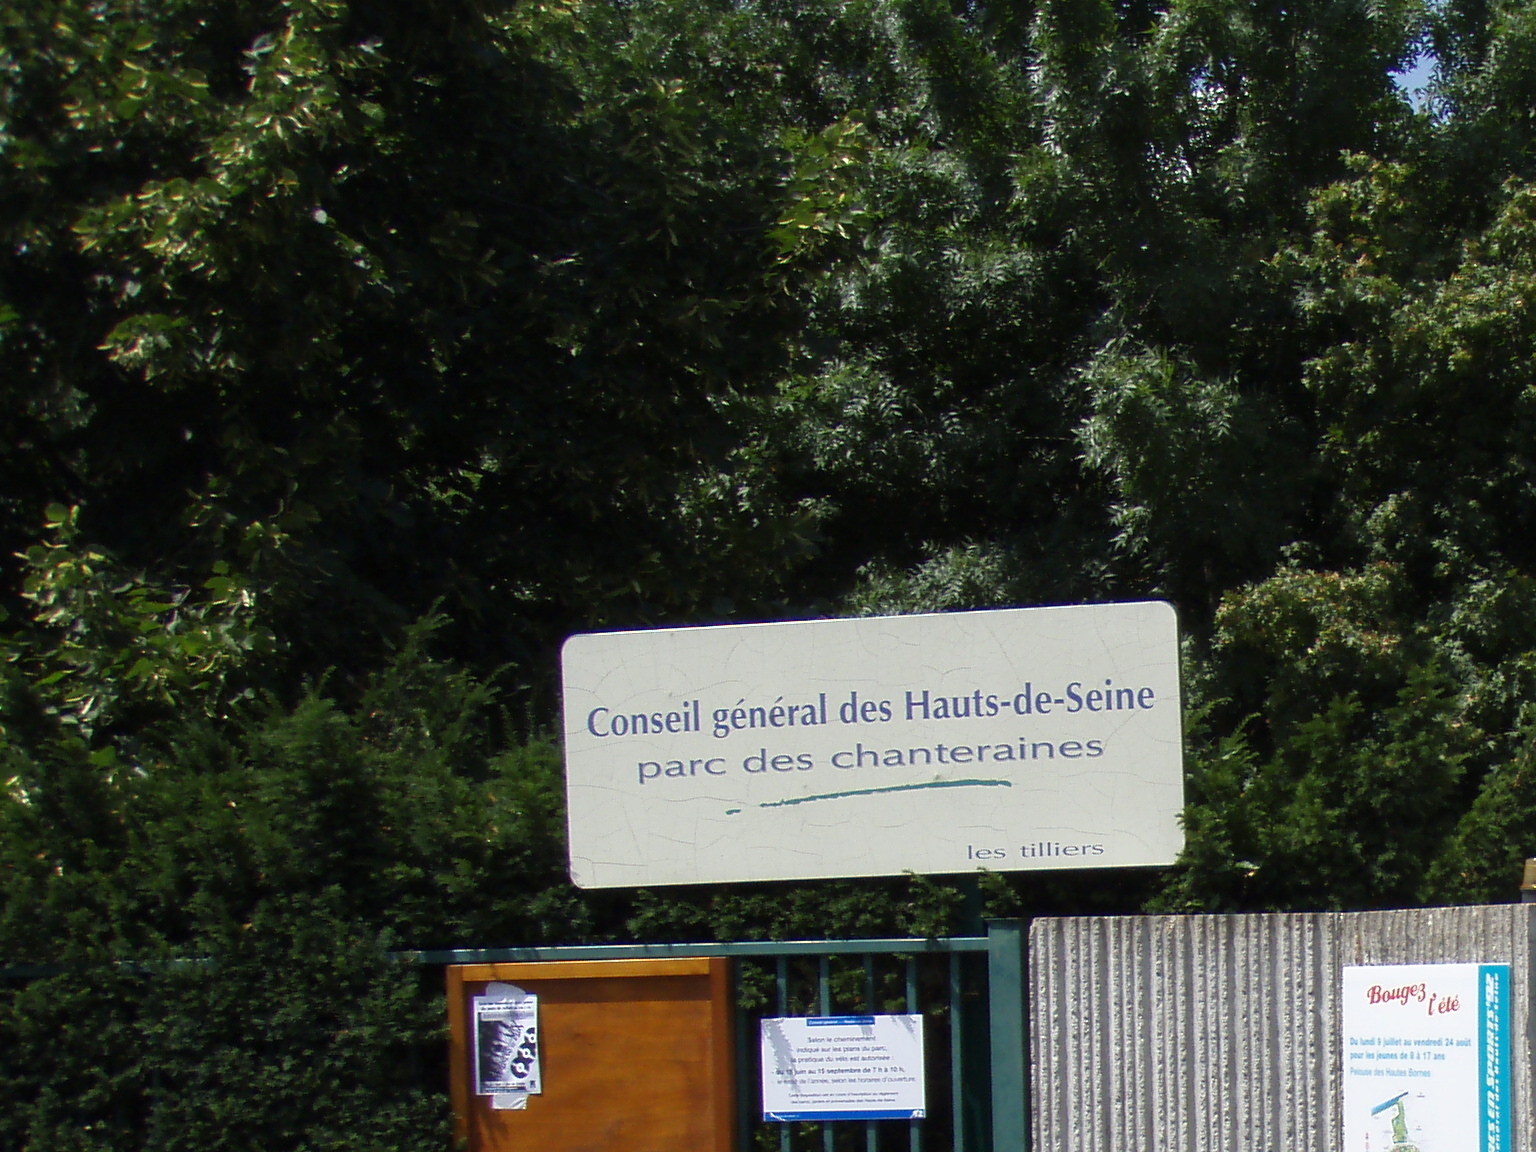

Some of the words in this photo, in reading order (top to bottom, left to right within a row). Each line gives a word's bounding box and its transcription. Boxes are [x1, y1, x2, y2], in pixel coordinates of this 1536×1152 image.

[586, 699, 701, 738] Conseil
[711, 692, 828, 740] général
[838, 691, 893, 725] des
[904, 678, 1156, 722] Hauts-de-Seine
[637, 755, 727, 786] parc
[742, 748, 814, 774] des
[830, 737, 1104, 770] chanteraines
[967, 845, 1007, 861] les
[1020, 841, 1105, 859] tilliers
[1367, 983, 1426, 1006] Bougez
[1428, 993, 1460, 1016] l'été
[1349, 1037, 1358, 1046] Du
[1360, 1037, 1375, 1046] lundi
[1383, 1037, 1401, 1047] juillet
[1414, 1037, 1443, 1046] vendredi
[1445, 1038, 1453, 1046] 24
[1456, 1038, 1471, 1047] août
[1350, 1052, 1364, 1060] pour
[1365, 1051, 1375, 1059] les
[1376, 1051, 1398, 1061] jeunes
[1400, 1051, 1408, 1059] de
[1423, 1051, 1431, 1060] 17
[1433, 1053, 1445, 1061] ans
[827, 1067, 861, 1075] septembre
